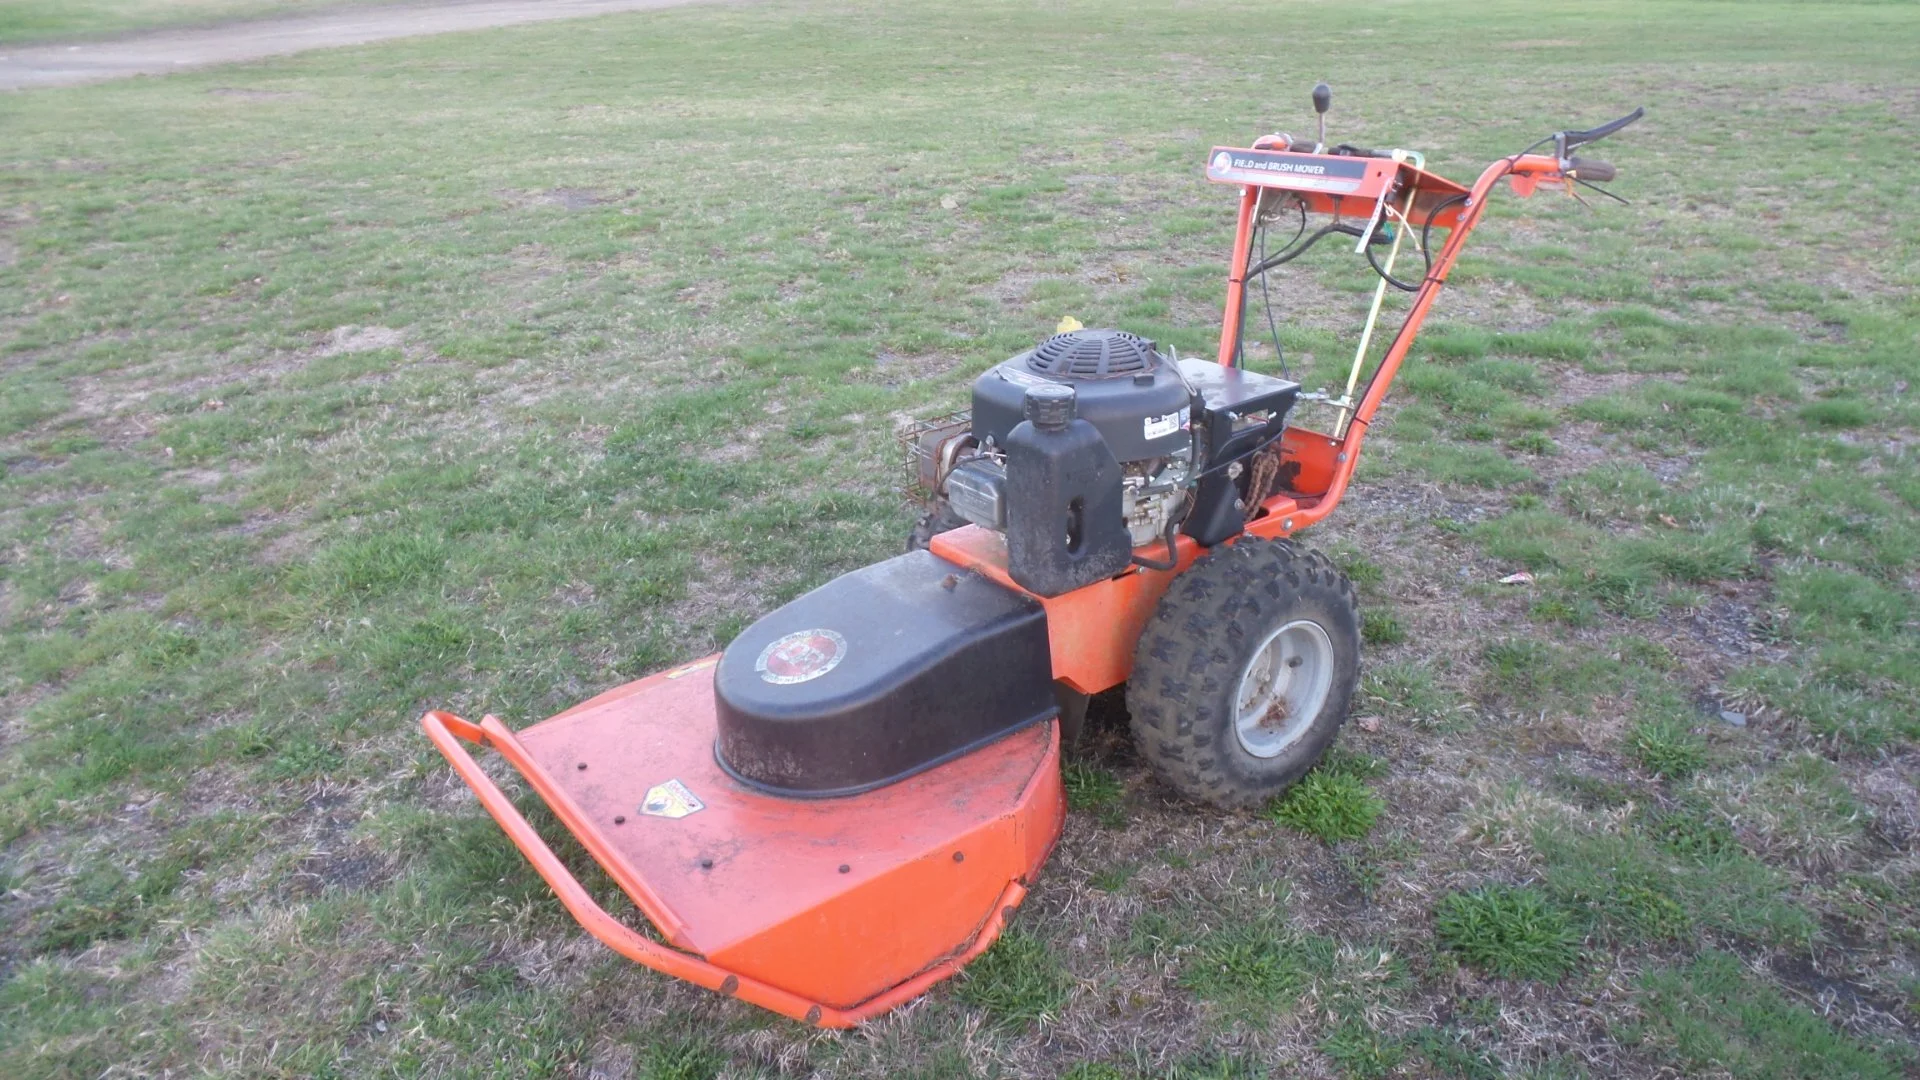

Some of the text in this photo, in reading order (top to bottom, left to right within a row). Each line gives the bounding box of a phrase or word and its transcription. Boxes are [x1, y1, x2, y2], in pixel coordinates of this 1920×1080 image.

[1254, 161, 1267, 170] and
[1268, 162, 1294, 172] BRUSH
[1294, 164, 1325, 175] MOWER
